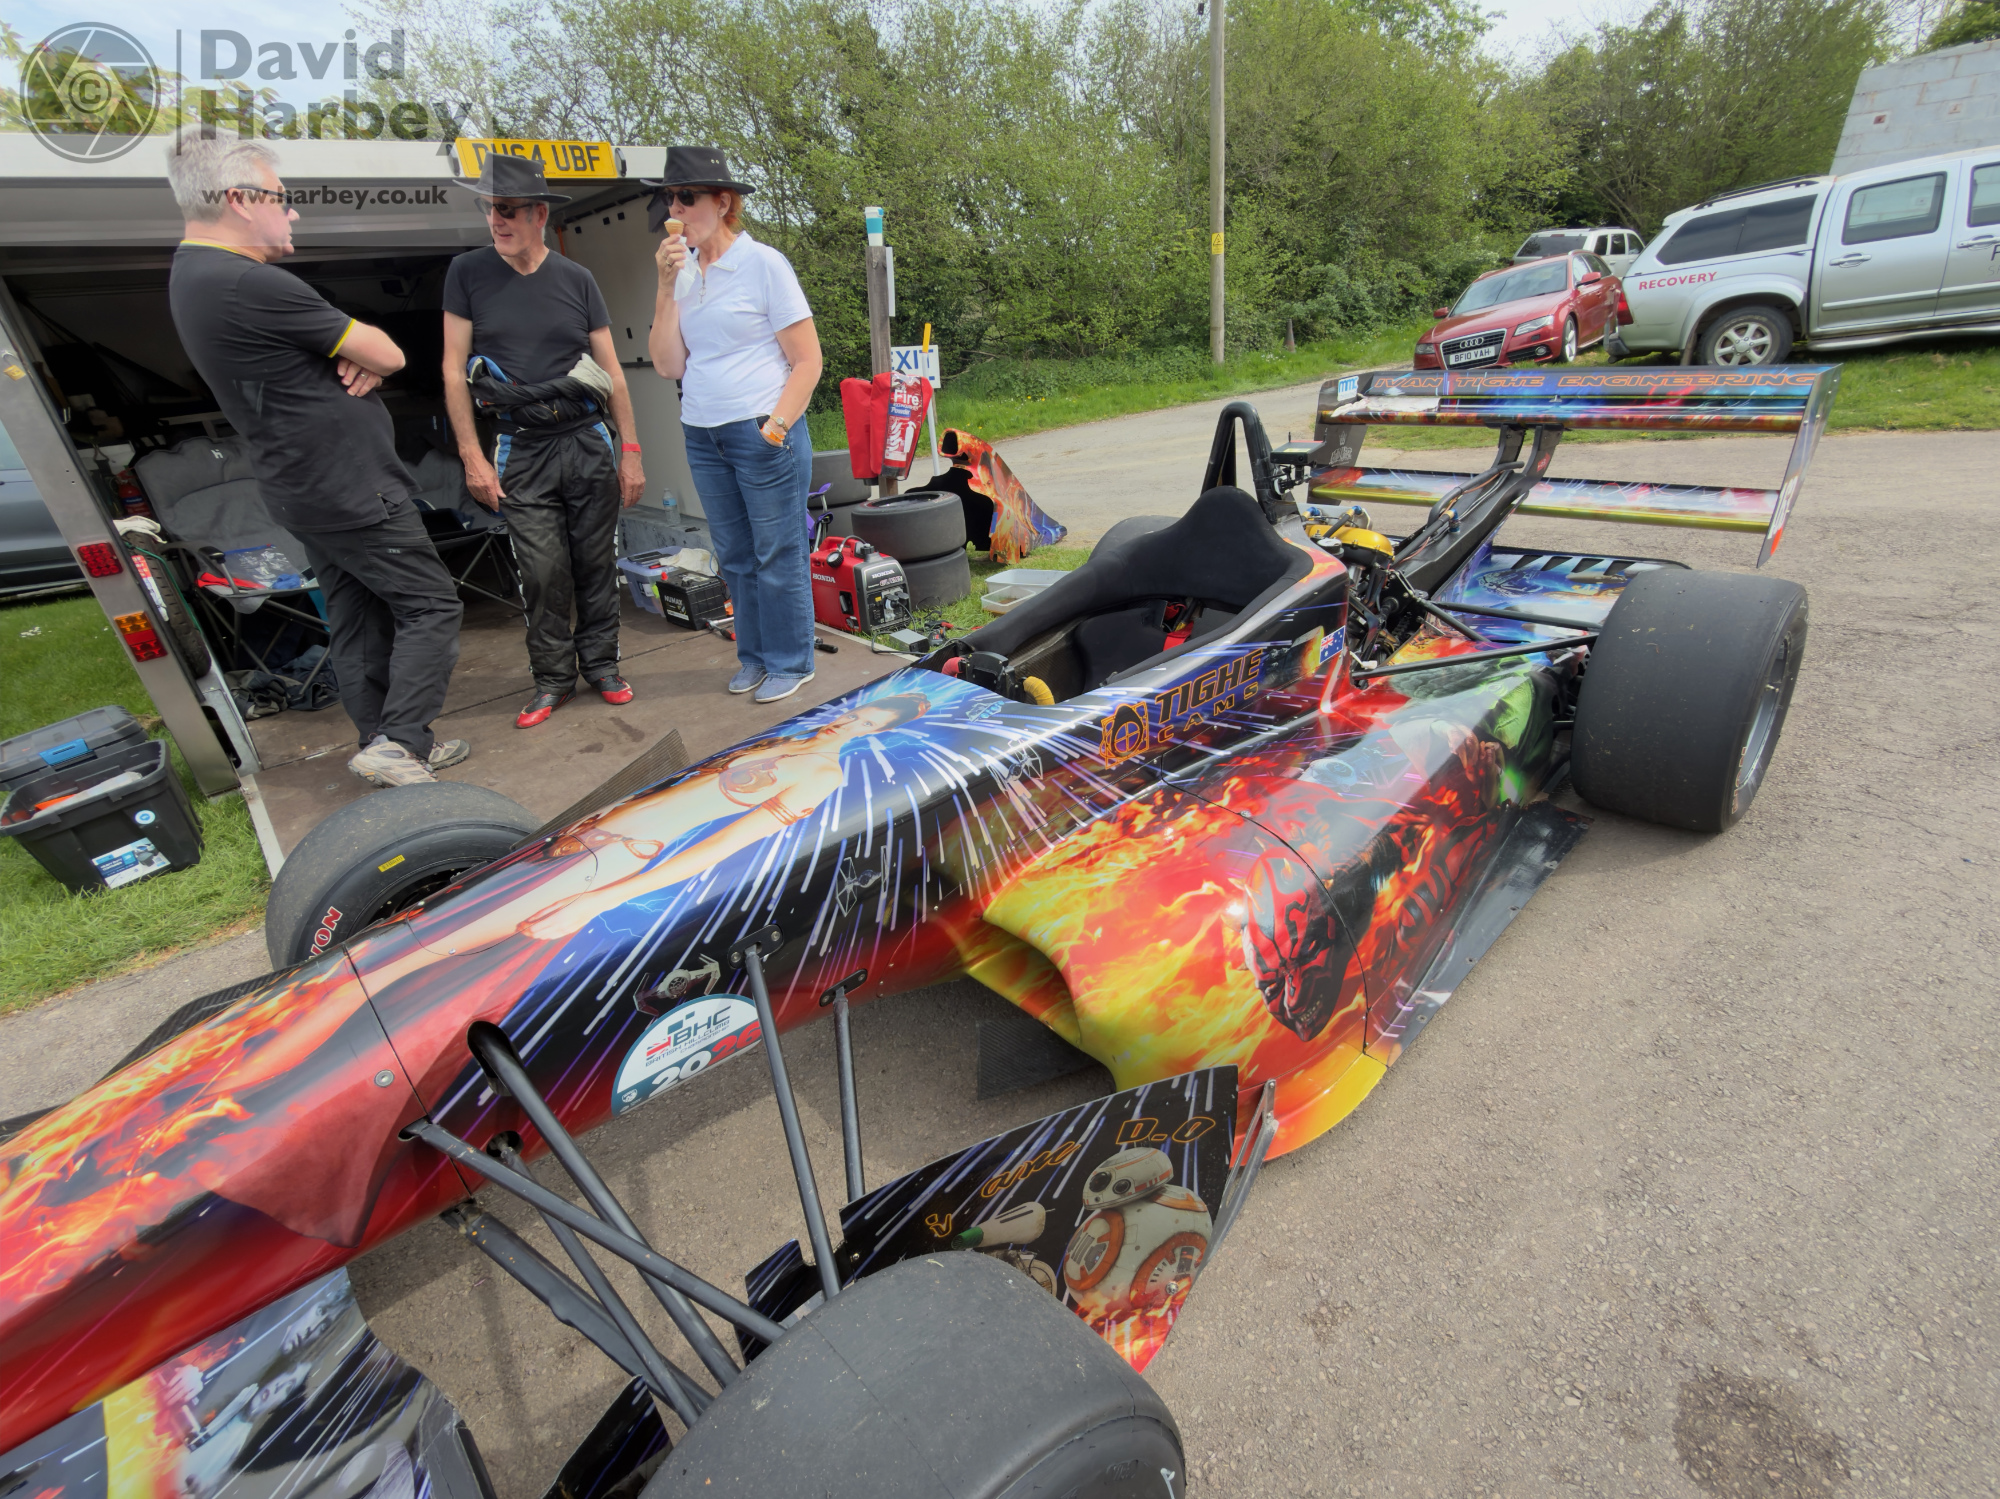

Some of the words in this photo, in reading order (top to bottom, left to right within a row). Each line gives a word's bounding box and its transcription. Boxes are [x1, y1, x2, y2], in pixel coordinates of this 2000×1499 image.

[551, 145, 600, 172] UBF
[1638, 271, 1718, 291] RECOVERY
[890, 349, 934, 370] XIT
[1473, 348, 1490, 359] VAH
[1374, 377, 1444, 388] IVAN
[1456, 375, 1546, 388] TIGHE
[1557, 372, 1819, 387] ENGINEERING
[894, 388, 920, 407] Fire
[812, 572, 836, 584] HONDA
[663, 594, 683, 606] NUMAX
[1154, 648, 1264, 724] TIGHE
[1158, 681, 1259, 744] CAMS
[672, 1004, 732, 1047] BHC
[645, 1043, 682, 1067] BRITISH
[648, 1019, 762, 1099] 2026
